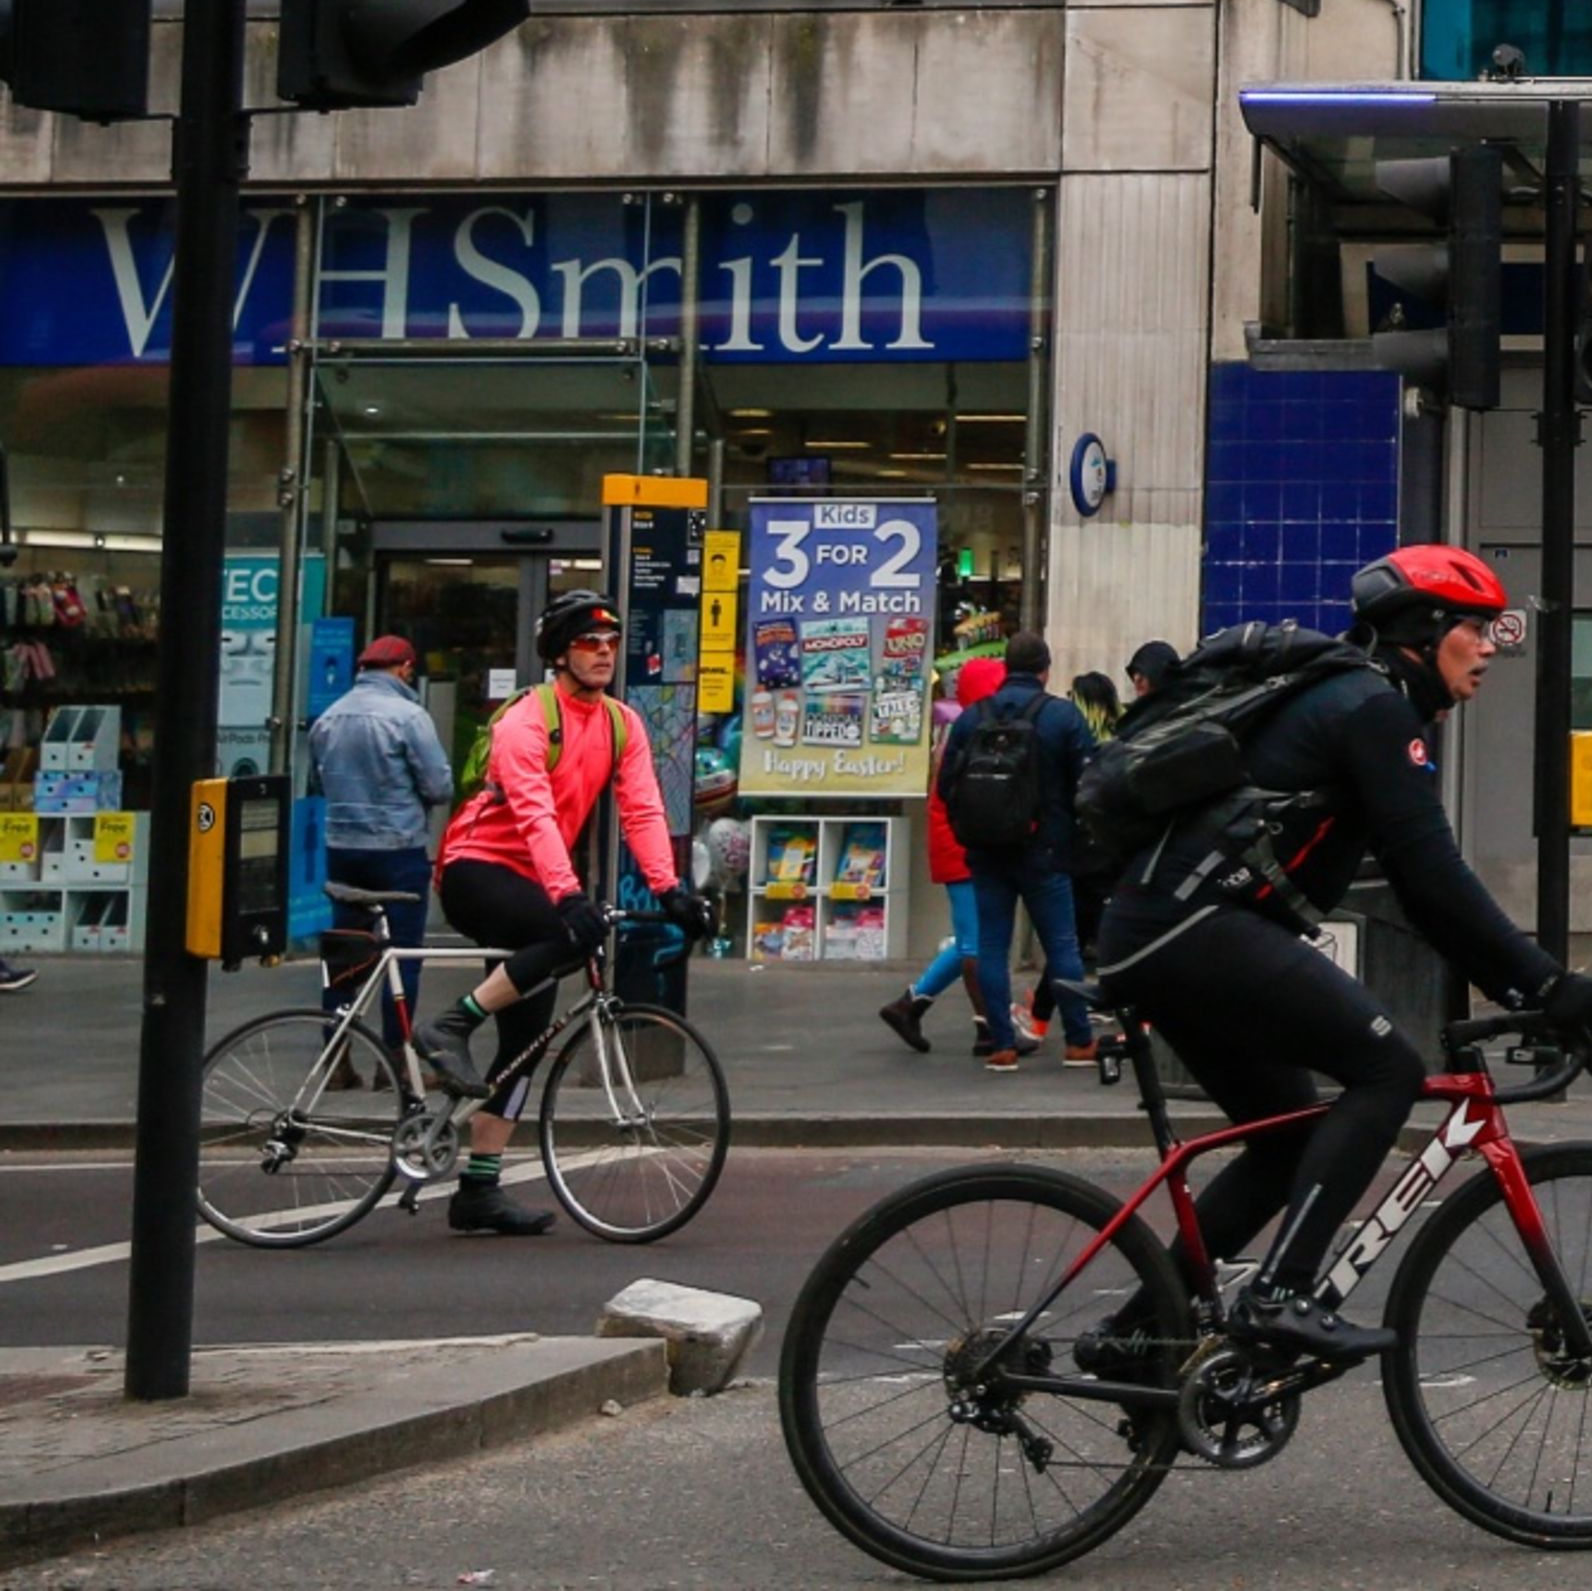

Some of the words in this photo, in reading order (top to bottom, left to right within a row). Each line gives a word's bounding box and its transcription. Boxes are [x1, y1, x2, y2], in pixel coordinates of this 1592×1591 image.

[91, 200, 935, 357] WHSmith
[821, 505, 870, 524] Kids
[762, 520, 810, 589] 3
[816, 545, 868, 565] FOR
[870, 519, 921, 588] 2
[760, 591, 805, 613] Mix
[812, 592, 830, 613] &
[839, 590, 921, 613] Match
[803, 636, 866, 651] MONOPOLY
[887, 632, 926, 653] UNO
[763, 750, 825, 779] Happy
[833, 749, 904, 778] Easter!
[1313, 1097, 1488, 1300] REK
